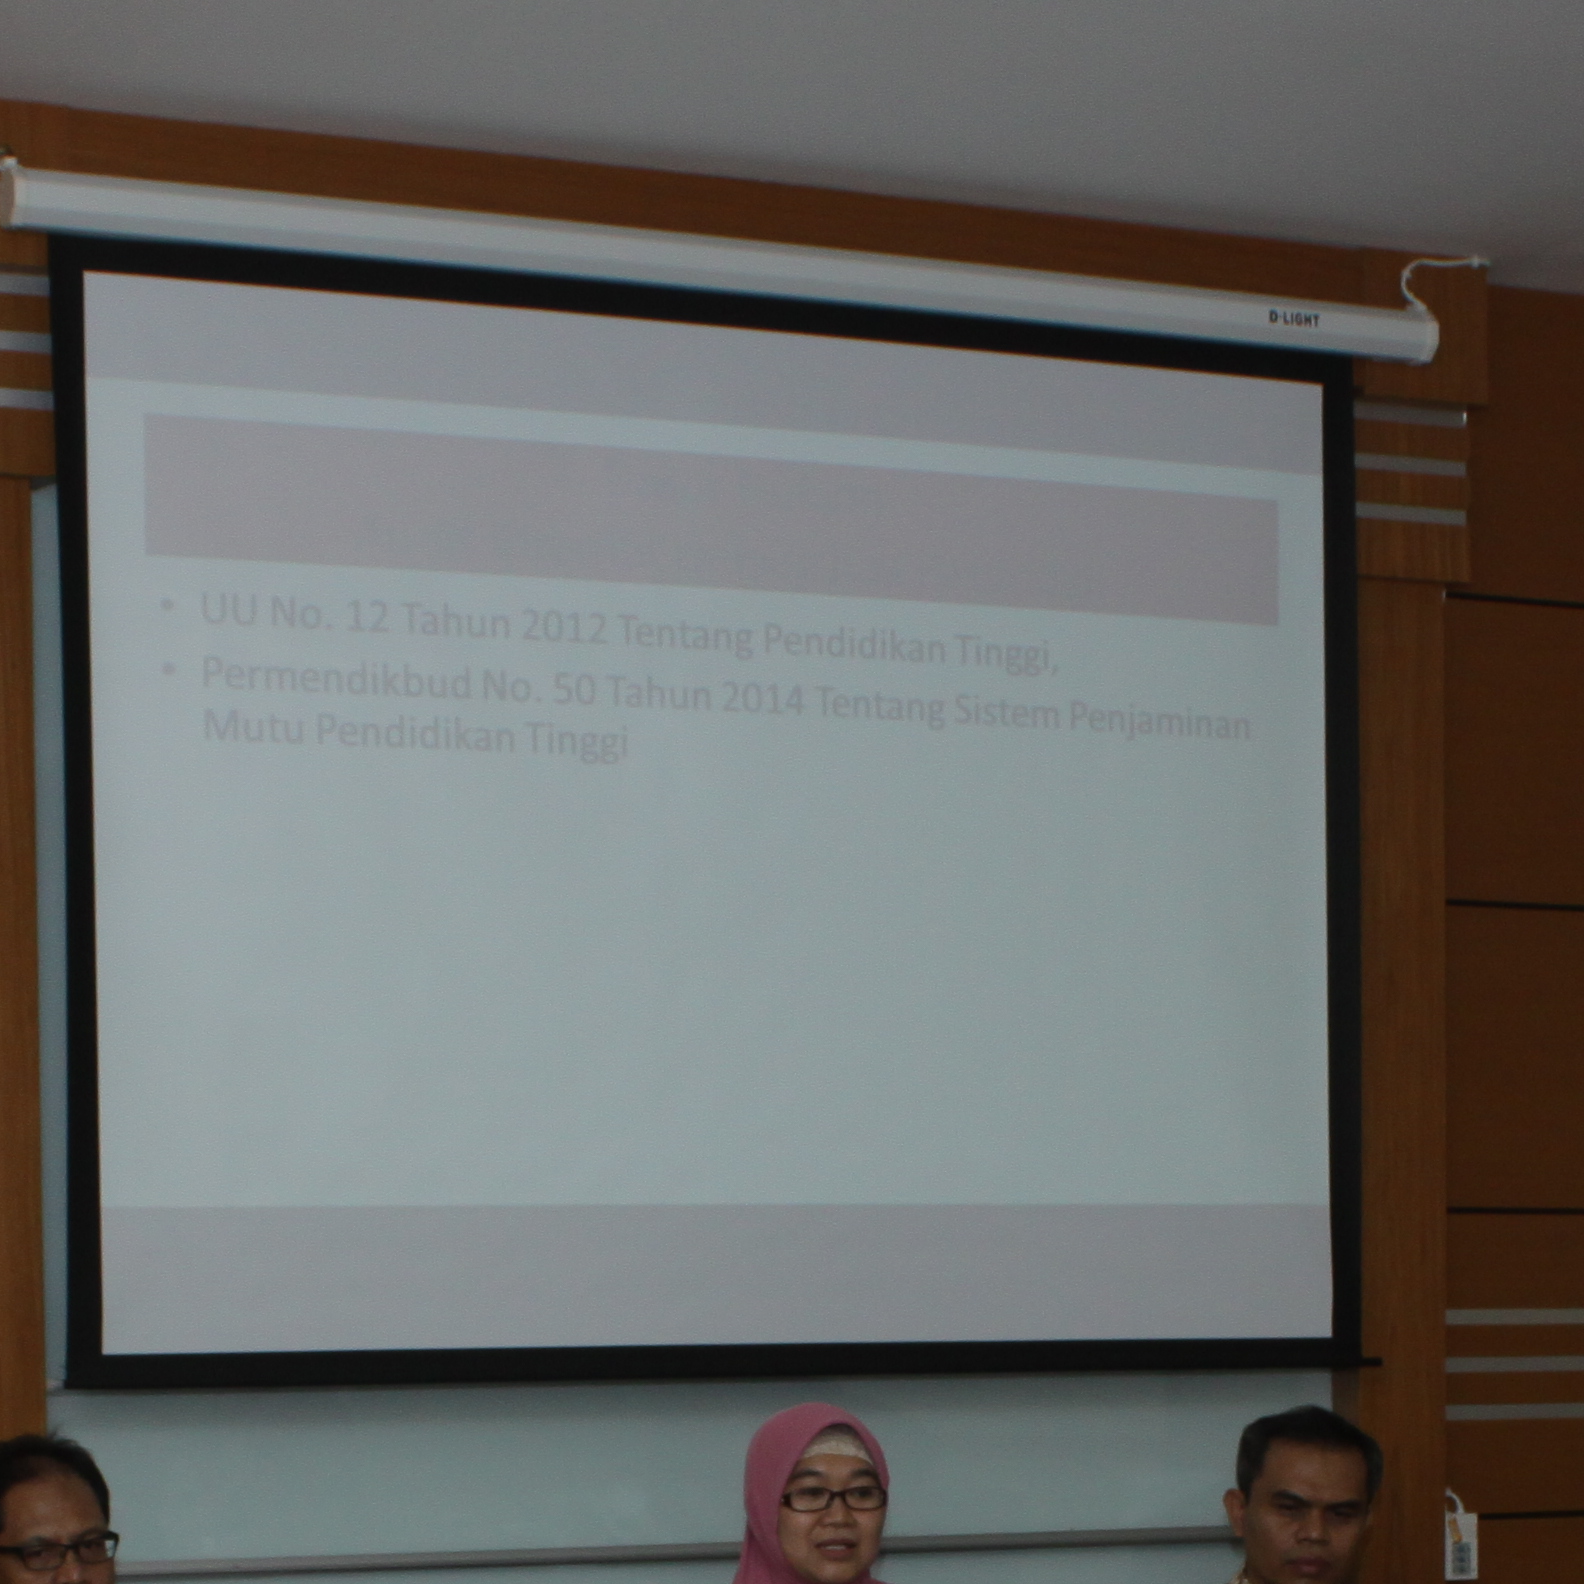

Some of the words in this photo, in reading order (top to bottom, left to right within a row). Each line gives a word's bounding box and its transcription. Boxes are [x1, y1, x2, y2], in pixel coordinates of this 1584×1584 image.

[201, 591, 257, 626] UU
[271, 595, 334, 630] No.
[347, 599, 389, 632] 12
[402, 601, 511, 638] Tahun
[522, 606, 607, 644] 2012
[618, 613, 753, 660] Tentang
[765, 622, 946, 663] Pendidikan
[954, 633, 1058, 677] Tinggi,
[203, 655, 472, 699] Permendikbud
[483, 669, 542, 703] No.
[554, 672, 596, 705] 50
[606, 674, 712, 711] Tahun
[722, 681, 804, 715] 2014
[815, 685, 945, 731] Tentang
[955, 693, 1060, 729] Sistem
[1070, 700, 1252, 741] Penjaminan
[204, 708, 304, 744] Mutu
[318, 713, 514, 752] Pendidikan
[526, 720, 628, 765] Tinggi
